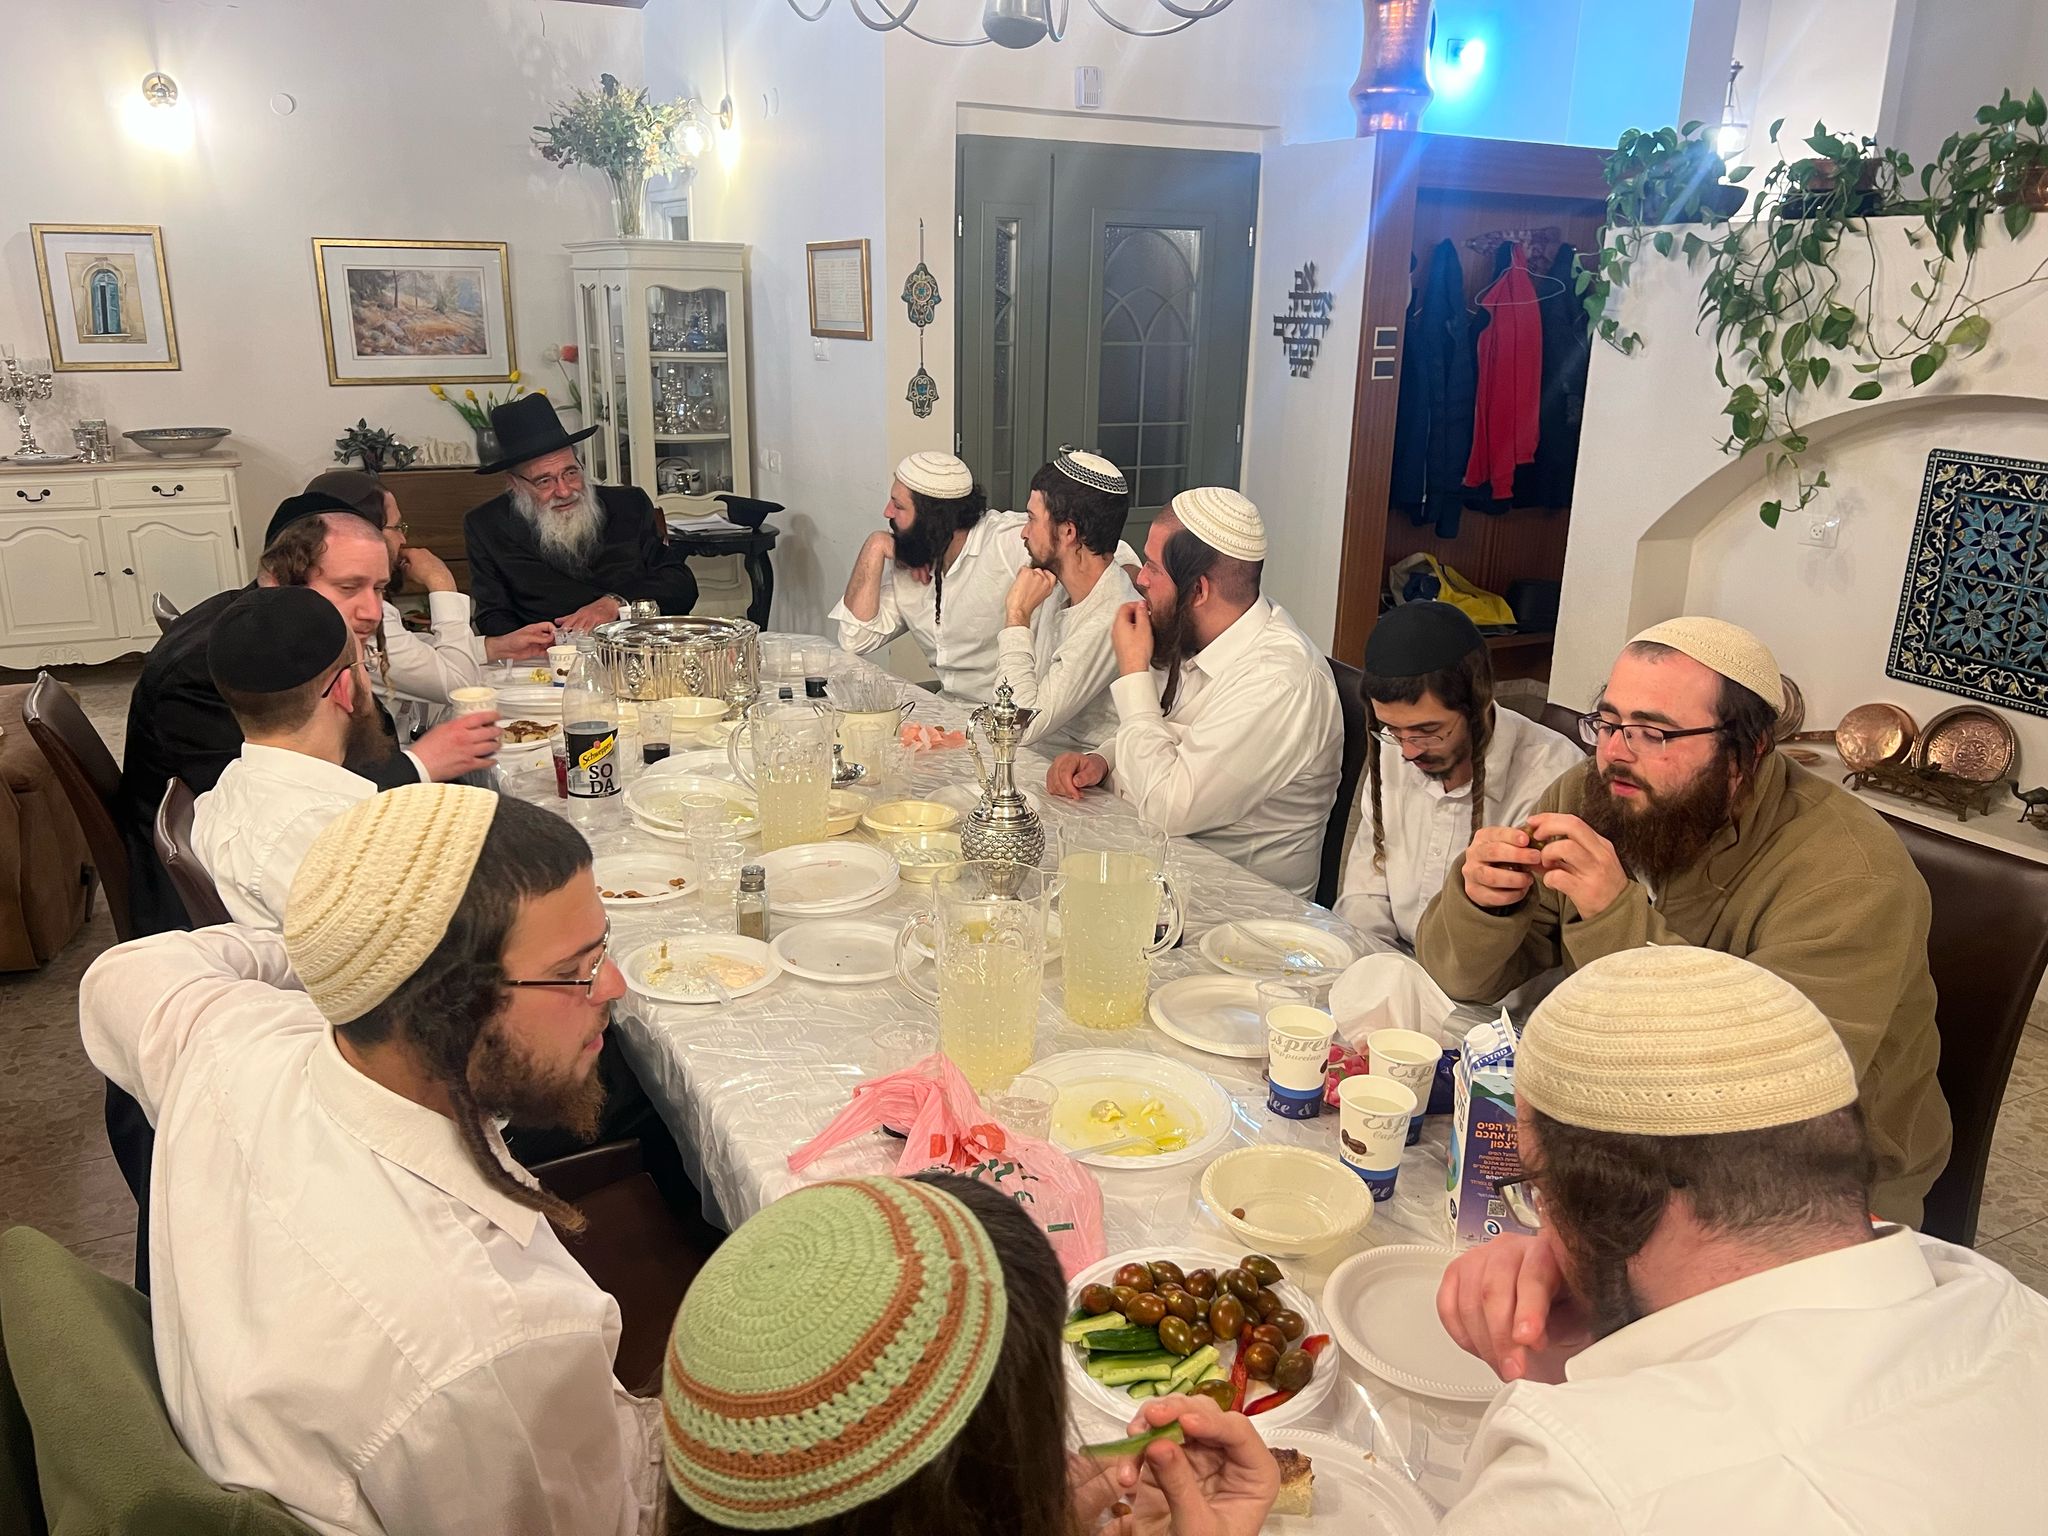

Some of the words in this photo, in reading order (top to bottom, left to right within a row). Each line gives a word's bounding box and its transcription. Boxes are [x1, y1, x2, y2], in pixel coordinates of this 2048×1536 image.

[1294, 261, 1316, 291] אם
[1273, 308, 1331, 338] ירושלים
[582, 741, 613, 765] Schweppes
[589, 763, 613, 780] SO
[590, 779, 615, 794] DA
[1476, 1048, 1508, 1068] מהדרין
[1475, 1130, 1506, 1140] אתכם
[1477, 1121, 1503, 1131] הפיס
